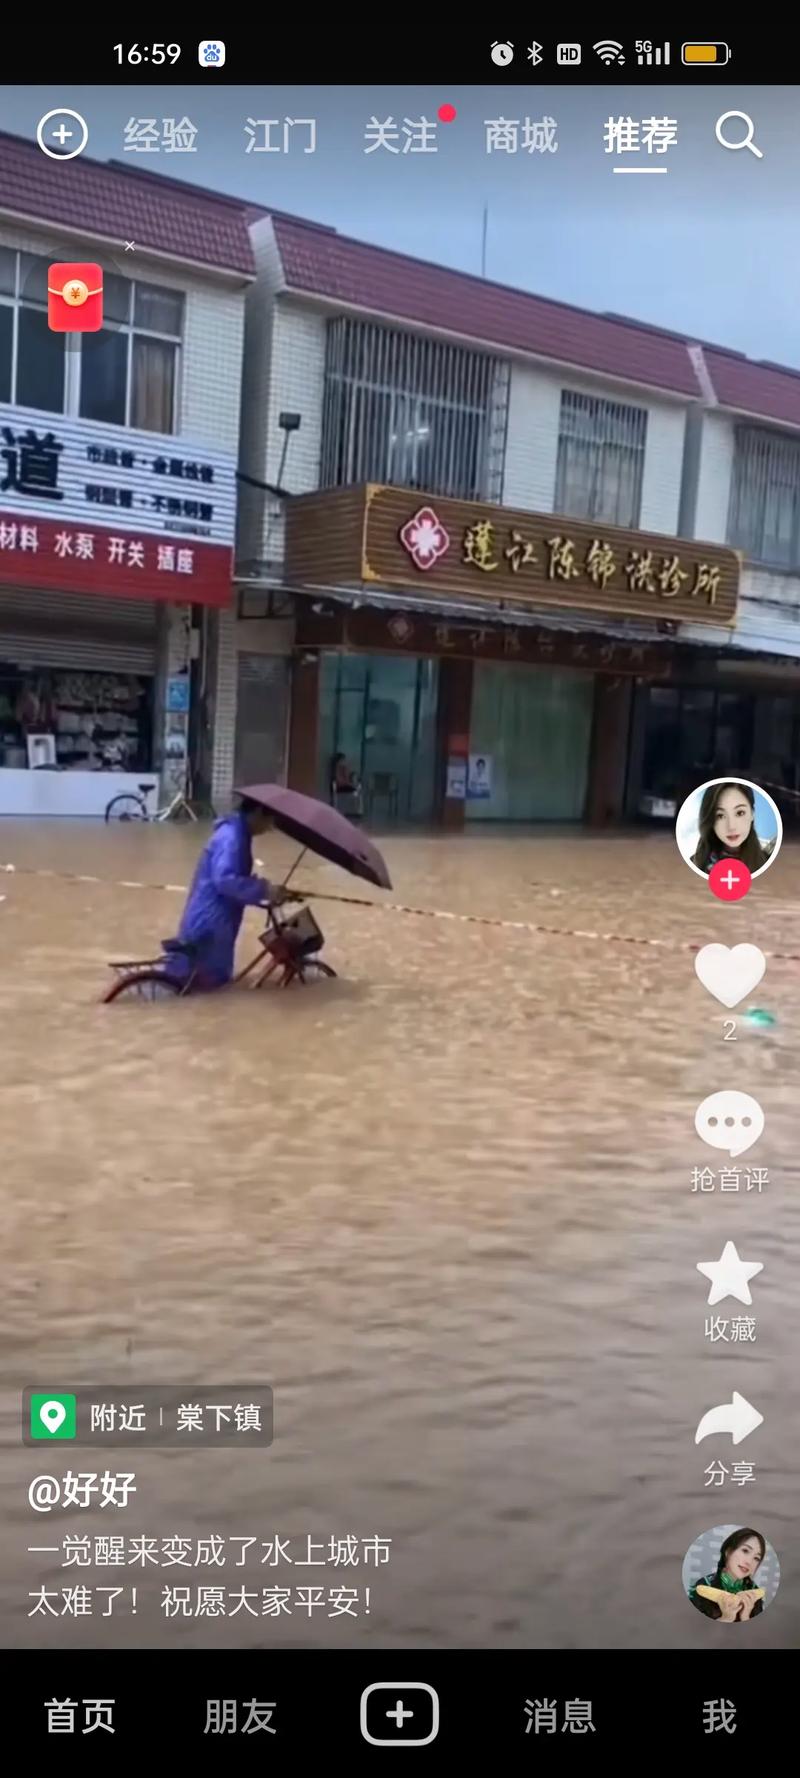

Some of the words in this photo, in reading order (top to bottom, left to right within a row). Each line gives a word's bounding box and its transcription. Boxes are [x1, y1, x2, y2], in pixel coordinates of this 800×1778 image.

[0, 427, 64, 500] 道
[54, 531, 94, 560] 水泵
[108, 537, 144, 568] 开关
[157, 544, 194, 574] 插座
